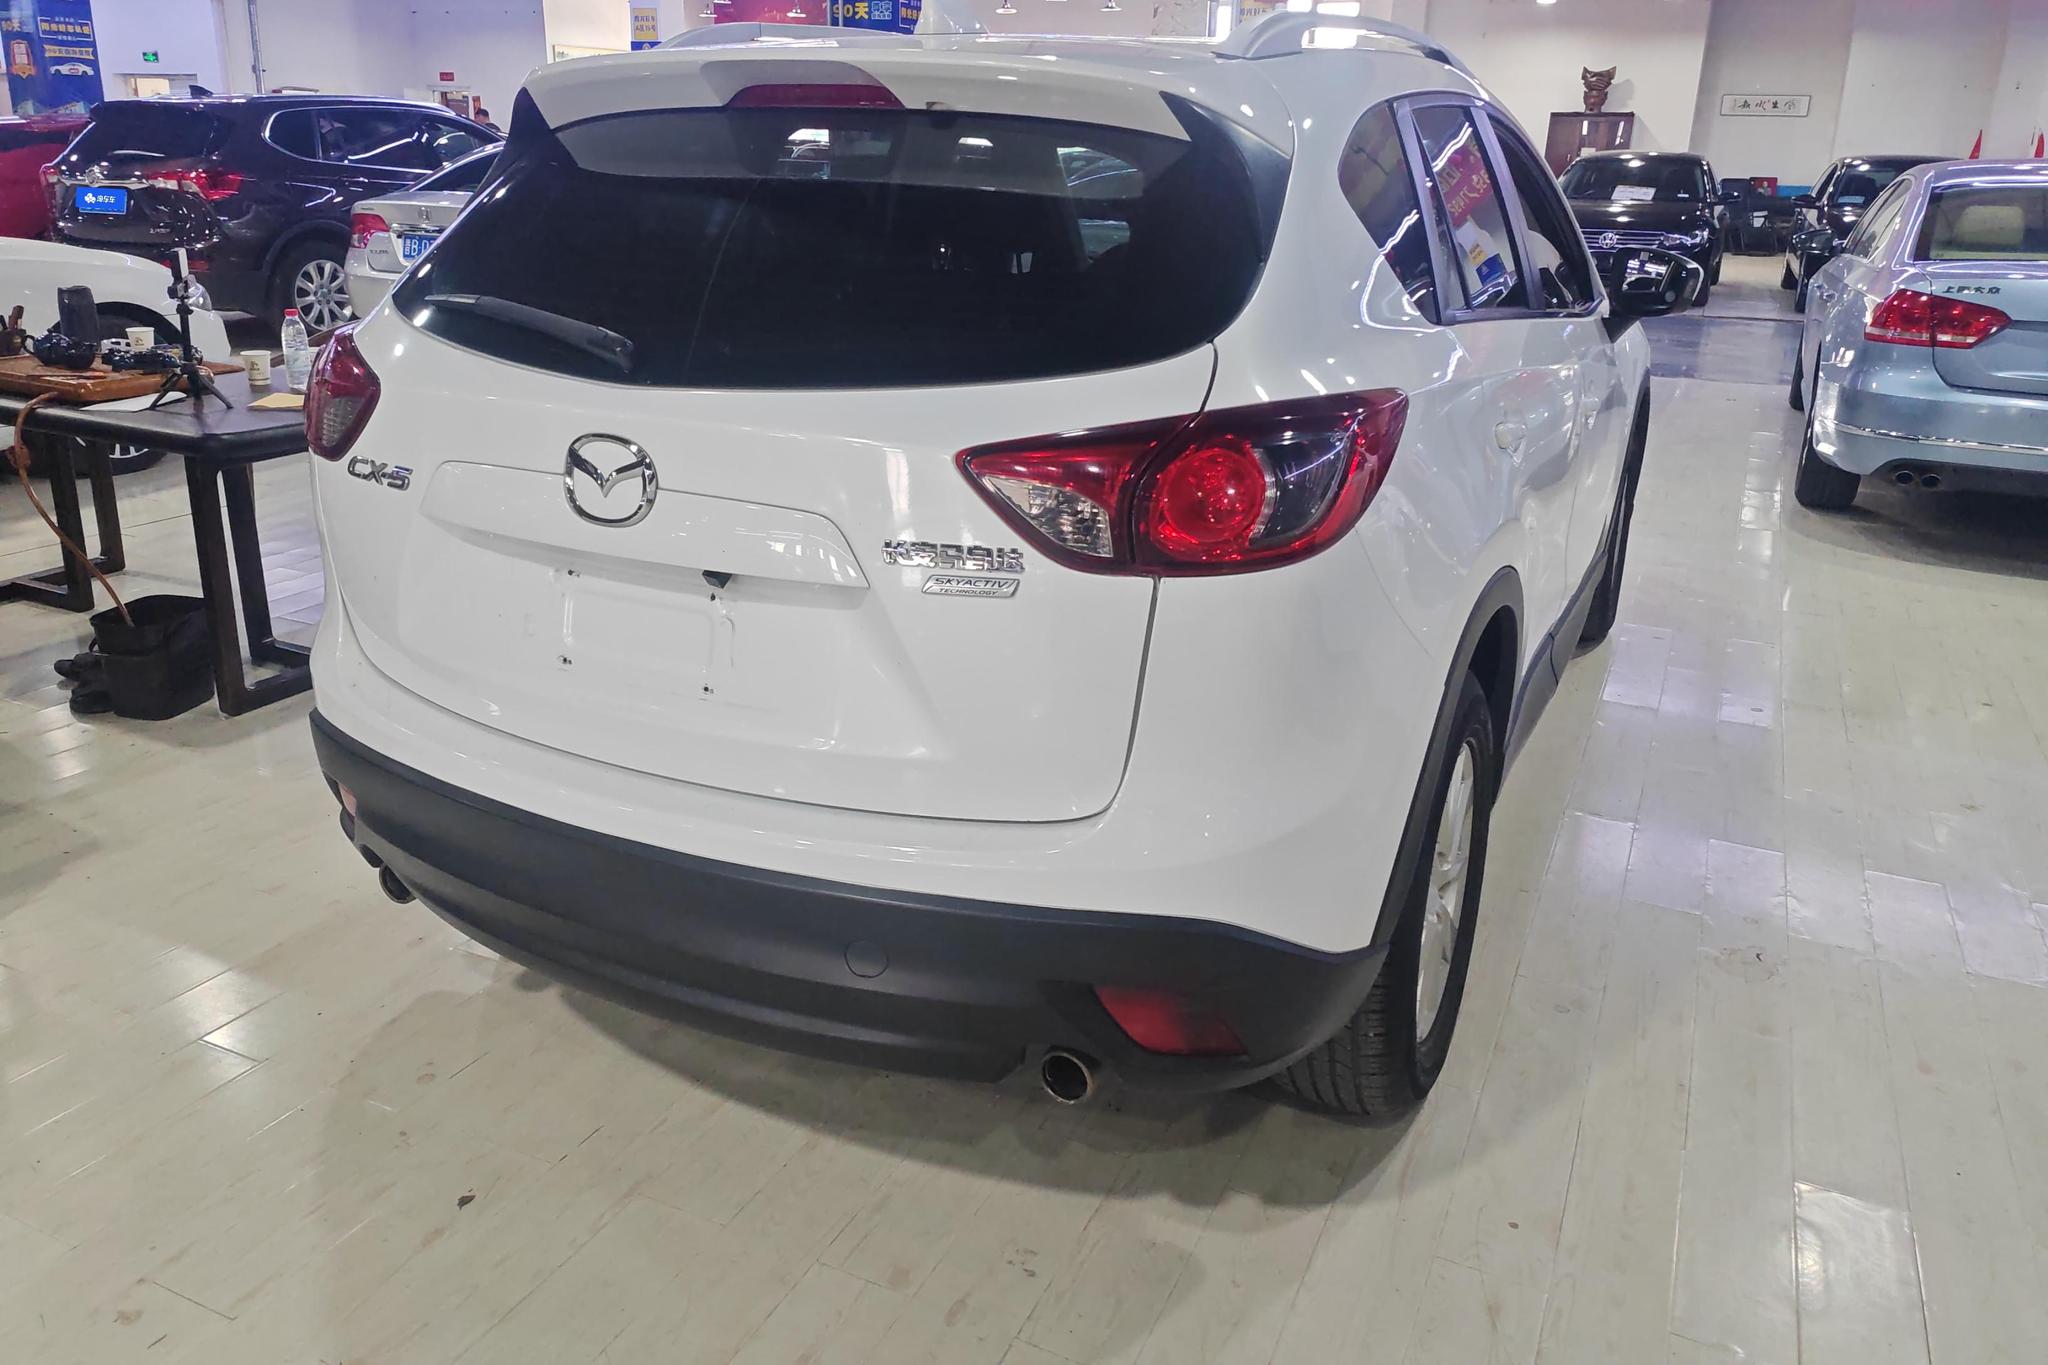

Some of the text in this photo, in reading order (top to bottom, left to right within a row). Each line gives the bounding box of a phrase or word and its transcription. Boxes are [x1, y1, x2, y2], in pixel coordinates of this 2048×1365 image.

[347, 456, 413, 491] CX-5
[933, 576, 1014, 589] SKYACTIV
[938, 588, 999, 596] TECHNOLOGY
